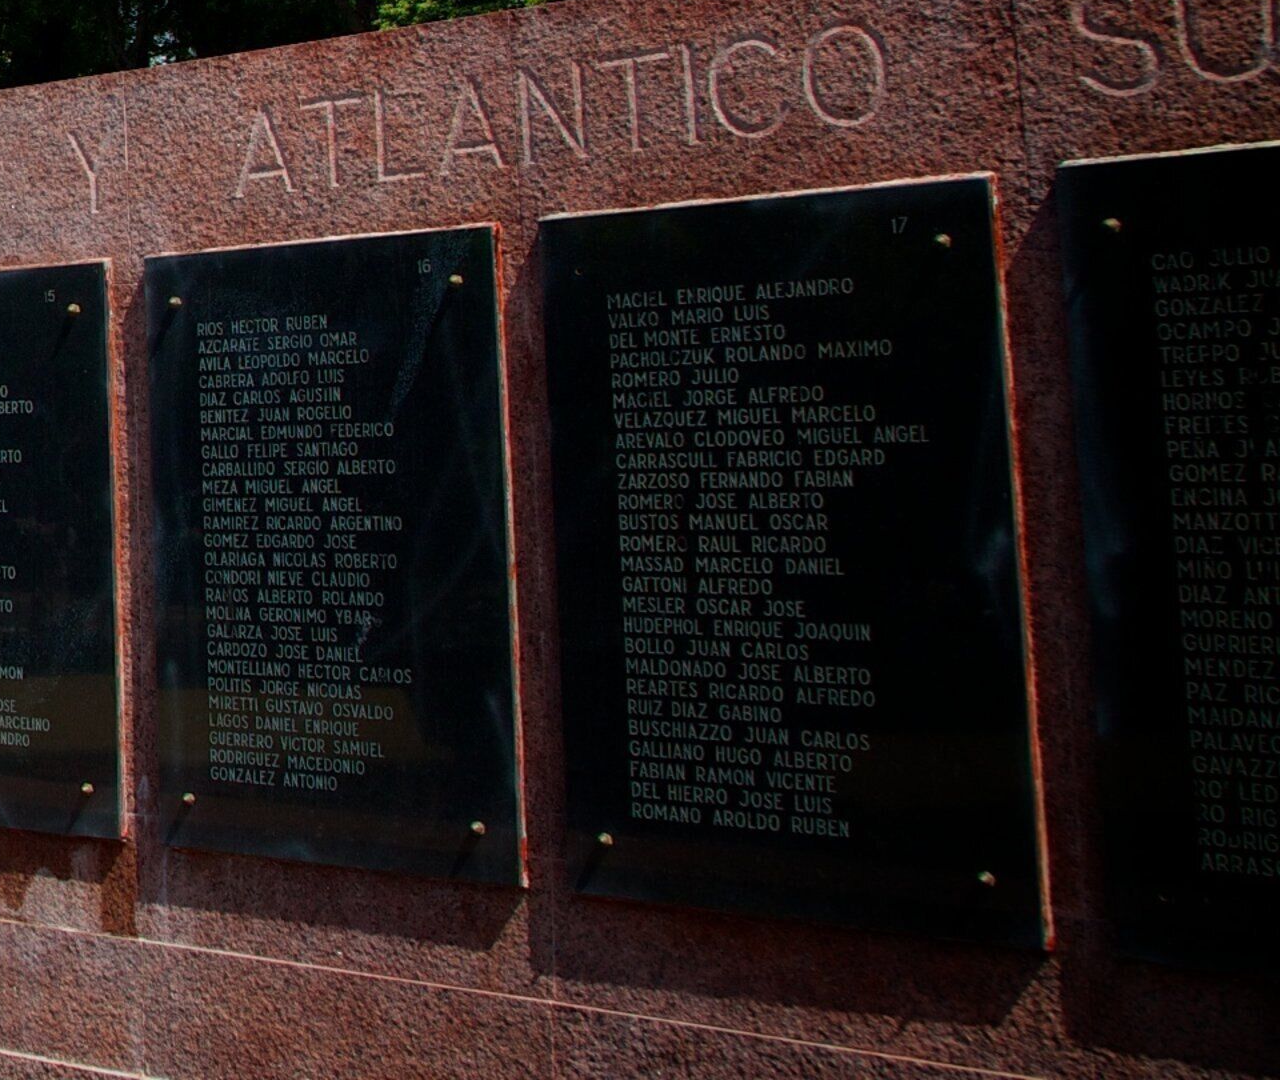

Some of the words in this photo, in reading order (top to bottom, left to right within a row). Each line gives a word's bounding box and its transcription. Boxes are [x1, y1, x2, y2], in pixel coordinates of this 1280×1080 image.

[232, 24, 886, 200] ATLANTICO
[607, 290, 665, 309] MACIEL
[676, 284, 744, 304] ENRIQUE
[755, 277, 854, 299] ALEJANDRO
[196, 321, 223, 336] RIOS
[230, 317, 278, 334] HECTOR
[285, 314, 327, 330] RUBEN
[608, 311, 659, 328] VALKO
[671, 307, 723, 324] MARIO
[733, 304, 769, 321] LUIS
[609, 332, 634, 349] DEL
[643, 328, 698, 346] MONTE
[710, 323, 785, 342] ERNESTO
[610, 348, 713, 368] PACHOLCZUK
[724, 344, 806, 362] ROLANDO
[817, 339, 893, 358] MAXIMO
[198, 373, 254, 388] CABRERA
[261, 370, 309, 386] ADOLFO
[317, 368, 344, 383] LUIS
[612, 391, 670, 408] MACIEL
[683, 388, 736, 406] JORGE
[748, 385, 824, 403] ALFREDO
[200, 408, 248, 423] BENITEZ
[257, 407, 289, 421] JUAN
[296, 404, 352, 420] ROGELIO
[614, 410, 706, 428] VELAZQUEZ
[717, 408, 778, 424] MIGUEL
[791, 404, 876, 422] MARCELO
[615, 432, 684, 448] AREVALO
[694, 429, 784, 446] CLODOVEO
[797, 427, 861, 444] MIGUEL
[872, 425, 929, 443] ANGEL
[201, 444, 238, 459] GALLO
[247, 442, 286, 458] FELIPE
[296, 441, 358, 456] SANTIAGO
[615, 452, 715, 468] CARRASCULL
[727, 450, 802, 466] FABRICIO
[813, 448, 885, 465] EDGARD
[618, 473, 689, 488] ZARZOSO
[700, 471, 783, 488] FERNANDO
[794, 470, 853, 486] FABIAN
[202, 497, 256, 512] GIMENEZ
[264, 497, 311, 511] MIGUEL
[322, 497, 360, 511] ANGEL
[618, 514, 678, 530] BUSTOS
[688, 514, 757, 530] MANUEL
[769, 514, 828, 530] OSCAR
[204, 551, 264, 566] OLARIAGA
[272, 552, 325, 567] NICOLAS
[334, 553, 397, 568] ROBERTO
[620, 556, 683, 572] MASSAD
[695, 556, 773, 574] MARCELO
[785, 558, 843, 575] DANIEL
[622, 596, 684, 614] MESLER
[696, 598, 751, 615] OSCAR
[763, 599, 805, 617] JOSE
[623, 616, 701, 635] HUDEPHOL
[713, 619, 782, 638] ENRIQUE
[794, 622, 871, 641] JOAQUIN
[207, 641, 267, 657] CARDOZO
[275, 644, 308, 659] JOSE
[315, 645, 361, 662] DANIEL
[624, 637, 674, 655] BOLLO
[686, 639, 730, 656] JUAN
[740, 641, 808, 660] CARLOS
[625, 657, 726, 678] MALDONADO
[738, 662, 780, 681] JOSE
[793, 664, 871, 685] ALBERTO
[207, 676, 251, 693] POLITIS
[259, 679, 298, 696] JORGE
[307, 682, 361, 699] NICOLAS
[626, 678, 697, 697] REARTES
[708, 682, 783, 702] RICARDO
[795, 686, 876, 707] ALFREDO
[208, 694, 258, 711] MIRETTI
[265, 698, 323, 715] GUSTAVO
[332, 702, 394, 720] OSVALDO
[628, 718, 732, 741] BUSCHIAZZO
[744, 726, 789, 744] JUAN
[800, 730, 870, 751] CARLOS
[628, 740, 704, 761] GALLIANO
[715, 746, 761, 765] HUGO
[773, 749, 852, 772] ALBERTO
[629, 760, 685, 780] FABIAN
[695, 766, 755, 786] RAMON
[766, 770, 835, 792] VICENTE
[631, 802, 701, 823] ROMANO
[712, 809, 780, 831] AROLDO
[791, 816, 849, 837] RUBEN
